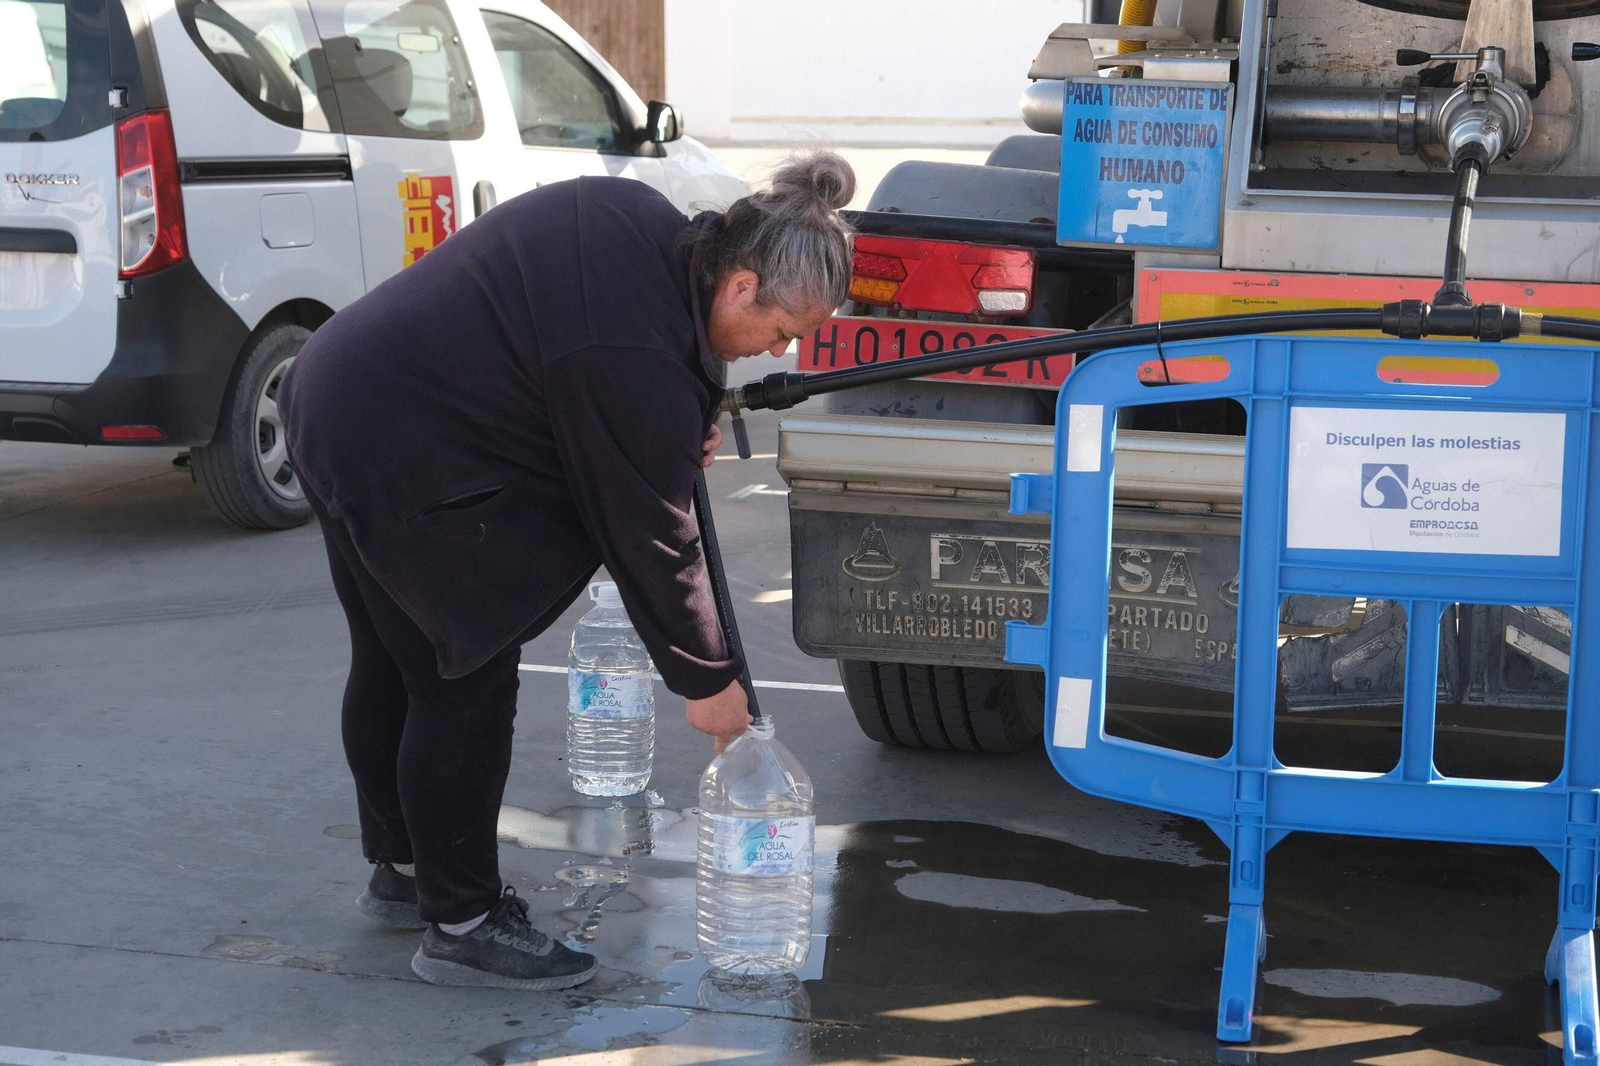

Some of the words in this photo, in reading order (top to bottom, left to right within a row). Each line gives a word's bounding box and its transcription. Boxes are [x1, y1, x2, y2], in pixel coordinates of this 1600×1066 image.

[1065, 82, 1103, 105] PARA
[1107, 84, 1204, 110] TRANSPORTE
[1209, 88, 1229, 110] DE
[1073, 118, 1113, 144] AGUA
[1117, 120, 1138, 145] DE
[1142, 122, 1218, 148] CONSUMO
[5, 173, 80, 185] DOKKER
[1099, 157, 1185, 185] HUMANO
[1326, 432, 1406, 449] Disculpen
[1411, 434, 1435, 448] las
[1440, 436, 1521, 450] molestias
[1411, 477, 1457, 495] Aguas
[1461, 479, 1480, 492] de
[1410, 496, 1480, 511] Córdoba
[855, 613, 998, 640] VILLARROBLEDO
[1107, 604, 1209, 634] PARTADO
[592, 691, 615, 699] AGUA
[758, 841, 785, 850] AGUA
[747, 852, 764, 861] DEL
[766, 851, 795, 861] ROSAL
